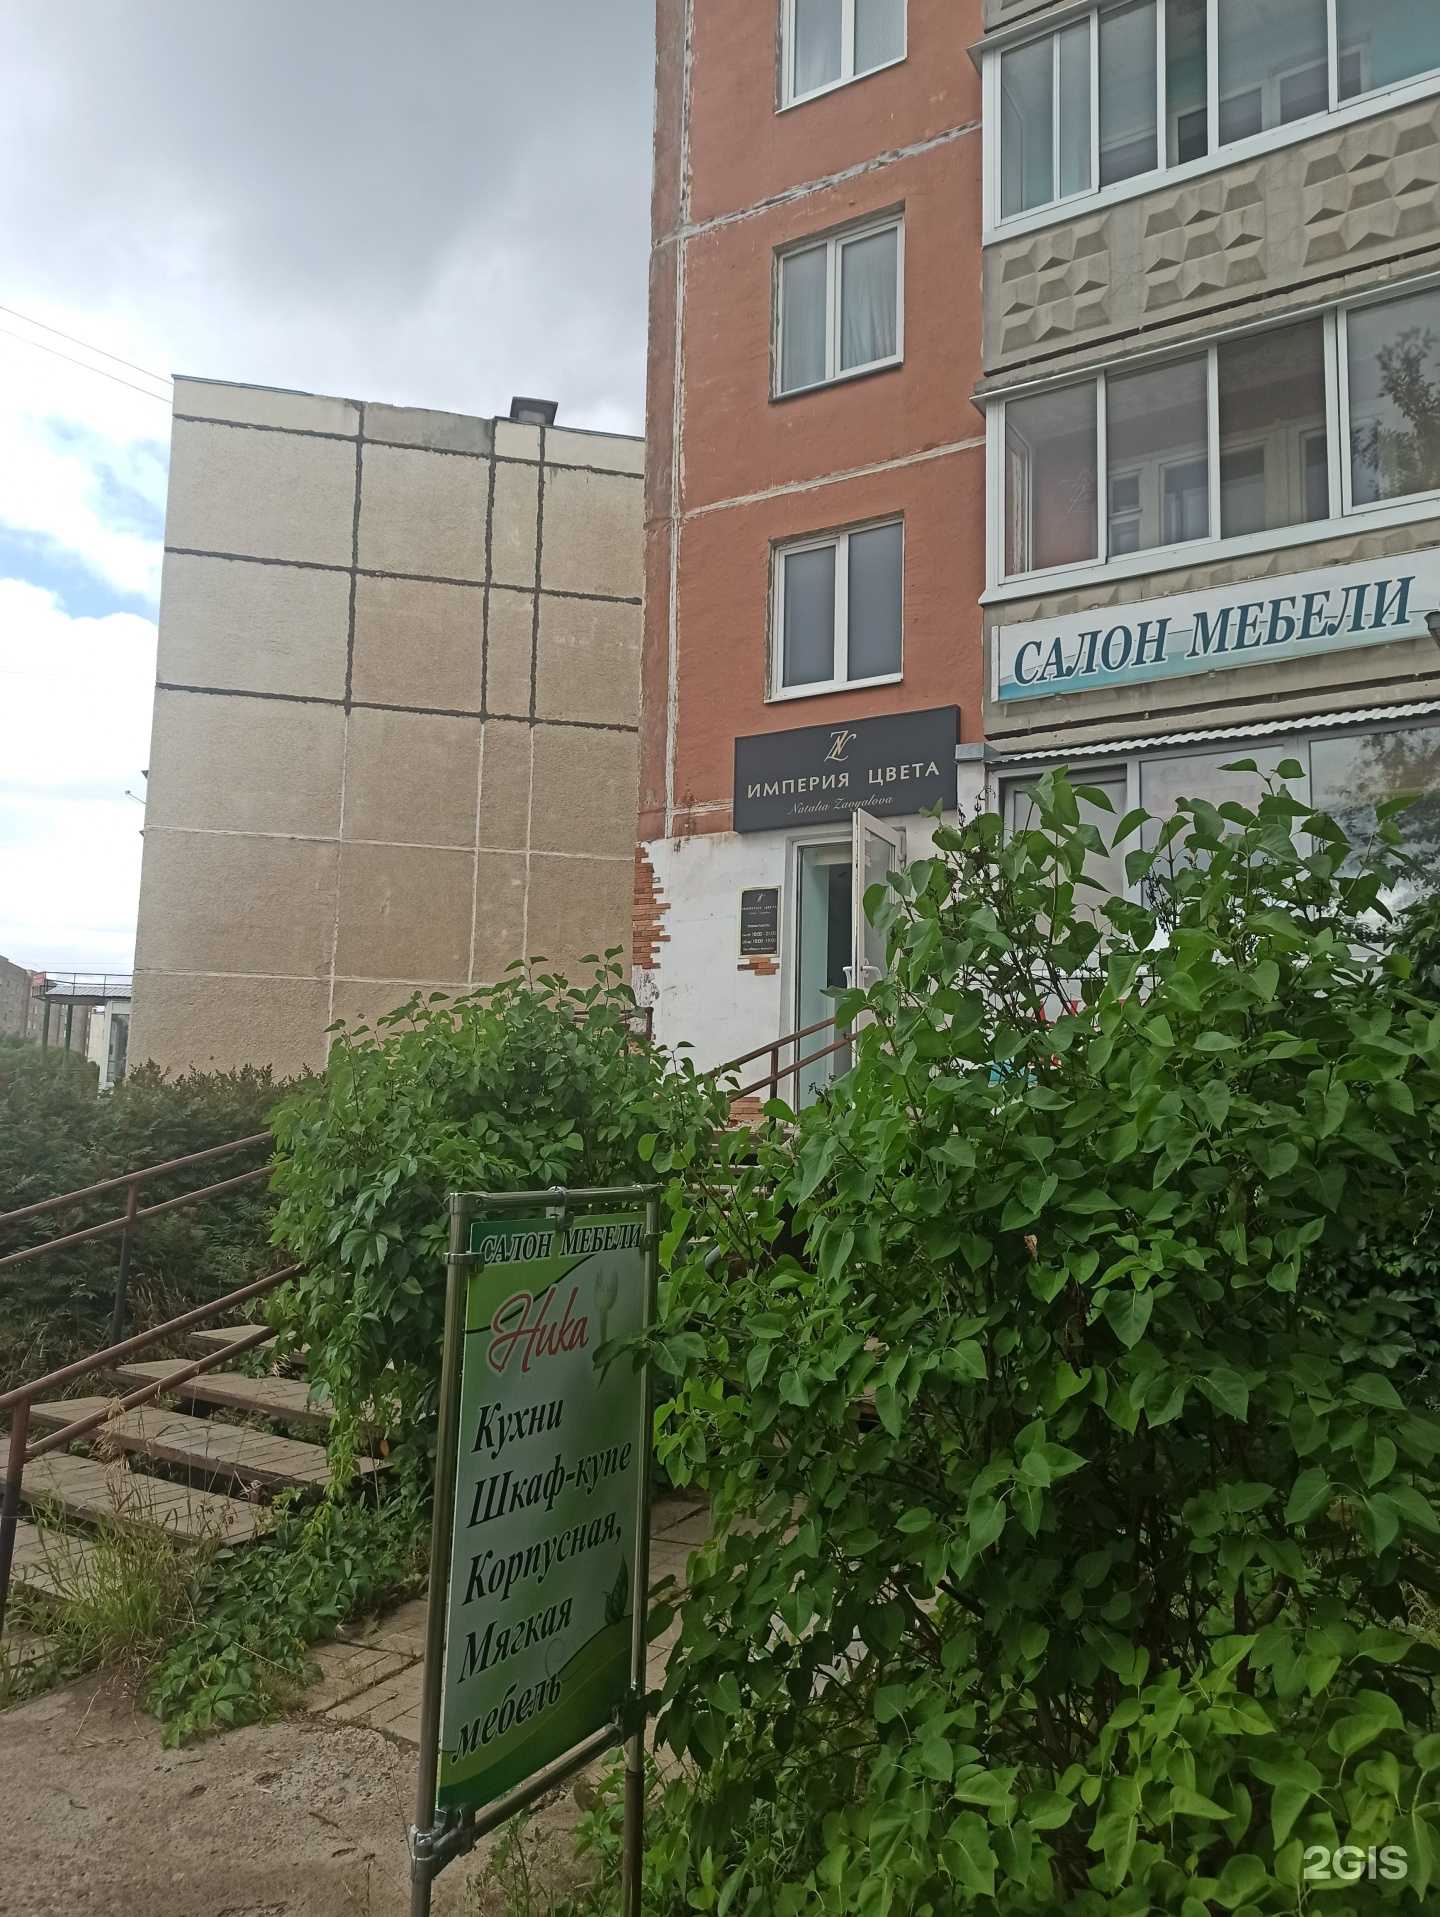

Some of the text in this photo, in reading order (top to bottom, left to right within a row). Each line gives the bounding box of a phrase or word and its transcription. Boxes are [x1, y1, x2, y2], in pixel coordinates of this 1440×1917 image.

[1014, 576, 1416, 685] САЛОН МЕБЕЛИ
[747, 761, 940, 800] ИМПЕРИЯ ЦВЕТА
[482, 1223, 643, 1265] САЛОН МЕБЕЛИ
[471, 1400, 563, 1460] Кухни
[466, 1442, 632, 1529] Шкаф-купе
[462, 1511, 622, 1606] Корпусная,
[457, 1597, 573, 1684] Мягкая
[451, 1673, 561, 1764] мебель
